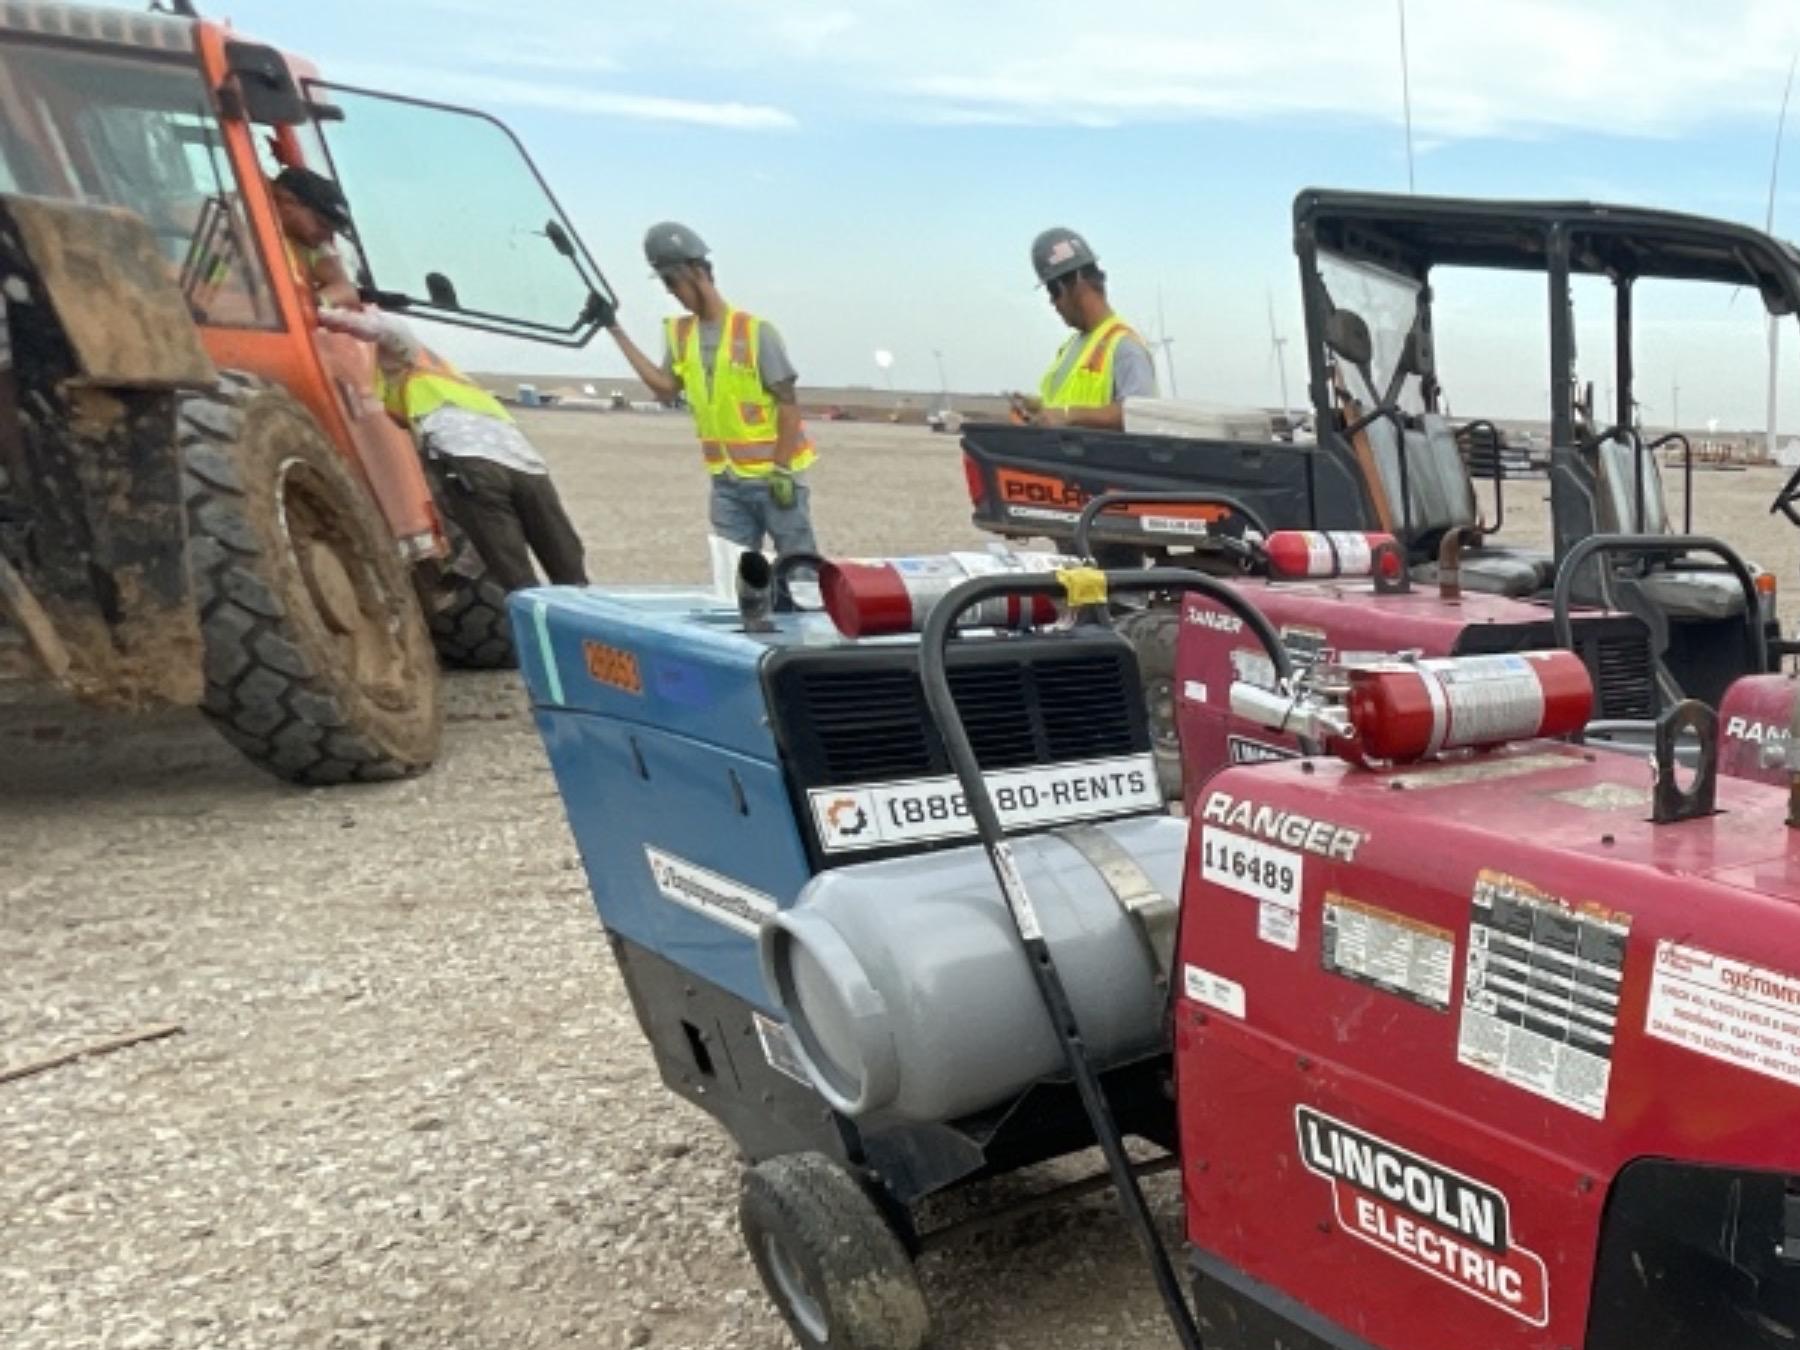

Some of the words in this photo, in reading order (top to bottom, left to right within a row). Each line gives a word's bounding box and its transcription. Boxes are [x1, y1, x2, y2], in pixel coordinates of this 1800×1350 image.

[1203, 791, 1361, 863] RANGER
[1204, 840, 1295, 894] 116489
[1307, 1119, 1496, 1246] LINCOLN
[1355, 1196, 1523, 1302] ELECTRIC
